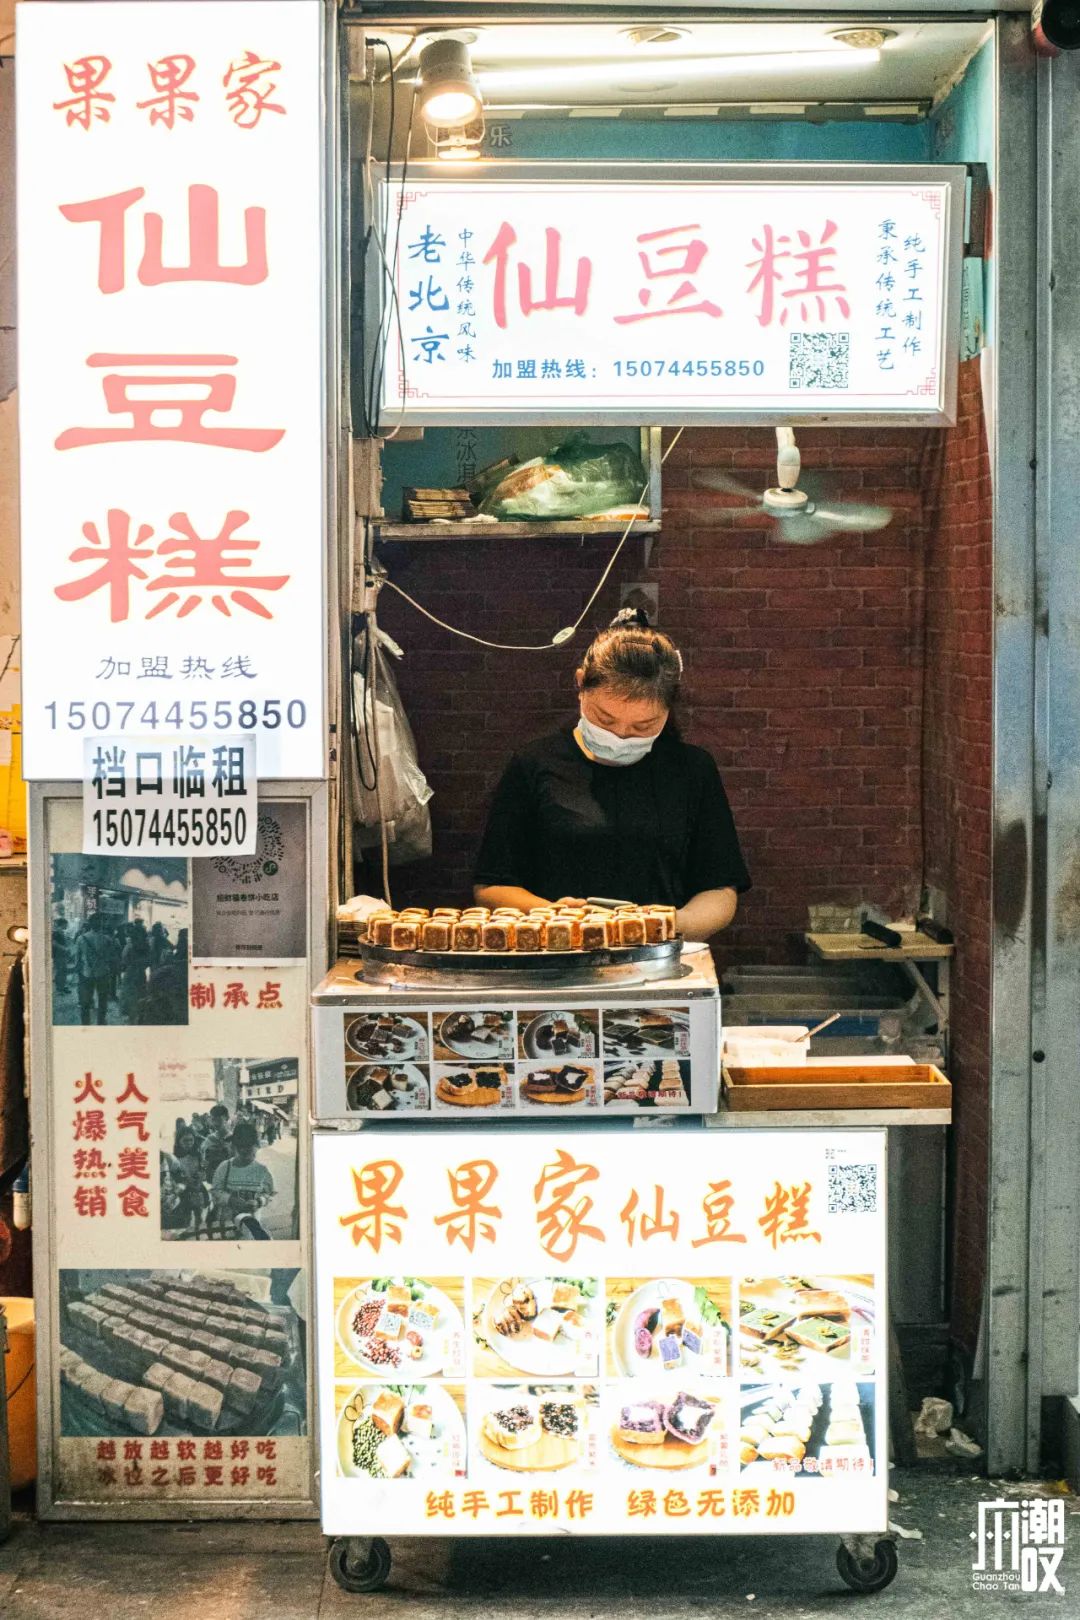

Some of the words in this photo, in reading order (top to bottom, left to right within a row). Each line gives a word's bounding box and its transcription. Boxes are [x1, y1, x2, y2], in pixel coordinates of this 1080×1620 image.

[52, 50, 288, 132] 果果家
[407, 223, 451, 365] 老北京
[455, 227, 477, 364] 中华传统风味
[481, 219, 851, 330] 仙豆糕
[874, 218, 899, 371] 秉承传统工艺
[901, 232, 927, 357] 纯手工制作
[54, 183, 291, 624] 仙豆糕
[612, 359, 766, 377] 15074455850
[95, 655, 258, 680] 加盟热线
[43, 698, 307, 731] 15074455850
[91, 745, 248, 800] 档口临租
[93, 807, 247, 847] 15074455850
[190, 980, 283, 1009] 制承点
[73, 1071, 108, 1217] 火爆热销
[115, 1072, 150, 1217] 人气美食
[96, 1439, 277, 1461] 越放越软越好吃
[425, 1489, 594, 1520] 纯手工制作
[626, 1488, 795, 1518] 绿色无添加
